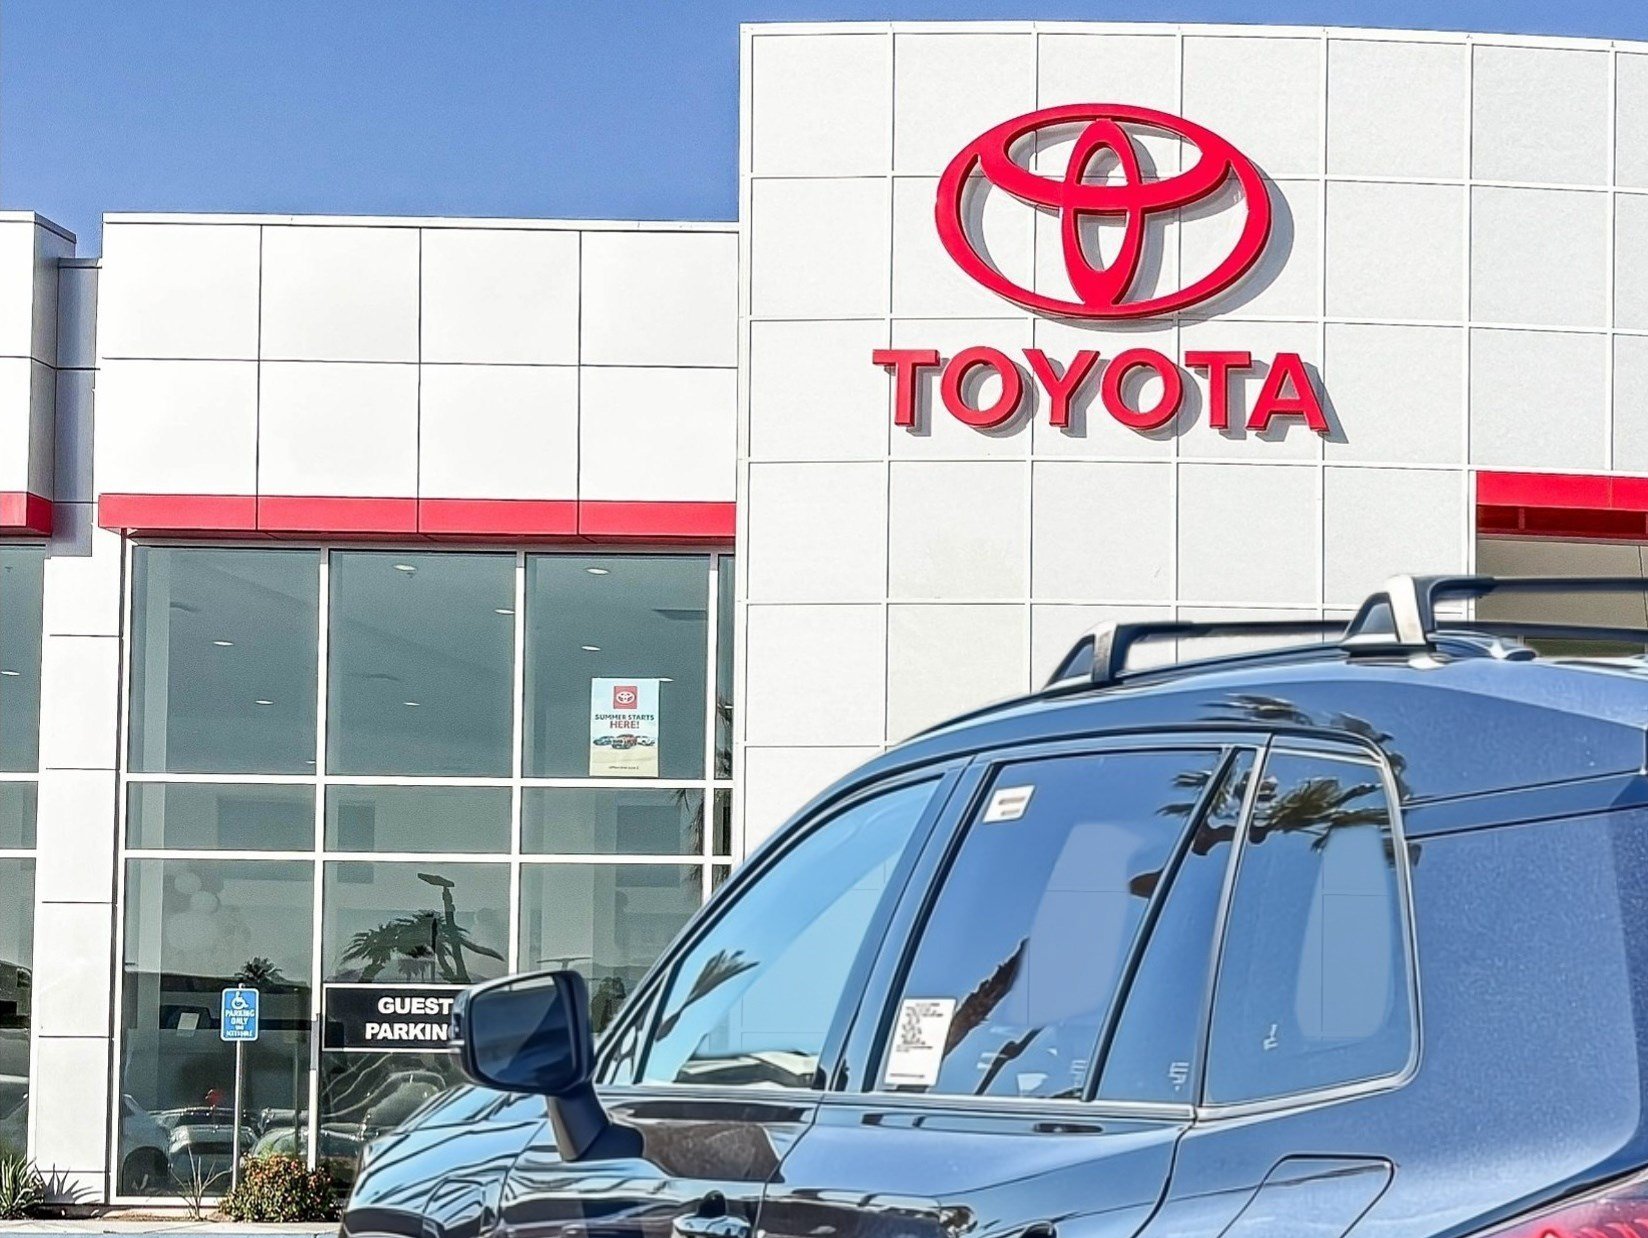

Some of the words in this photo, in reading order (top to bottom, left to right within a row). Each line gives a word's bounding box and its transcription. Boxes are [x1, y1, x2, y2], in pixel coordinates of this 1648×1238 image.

[872, 346, 1329, 433] TOYOTA
[609, 721, 640, 729] HERE!
[377, 997, 454, 1014] GUEST
[225, 1009, 255, 1018] PARKING
[230, 1017, 249, 1025] ONLY
[365, 1023, 451, 1040] PARKIN
